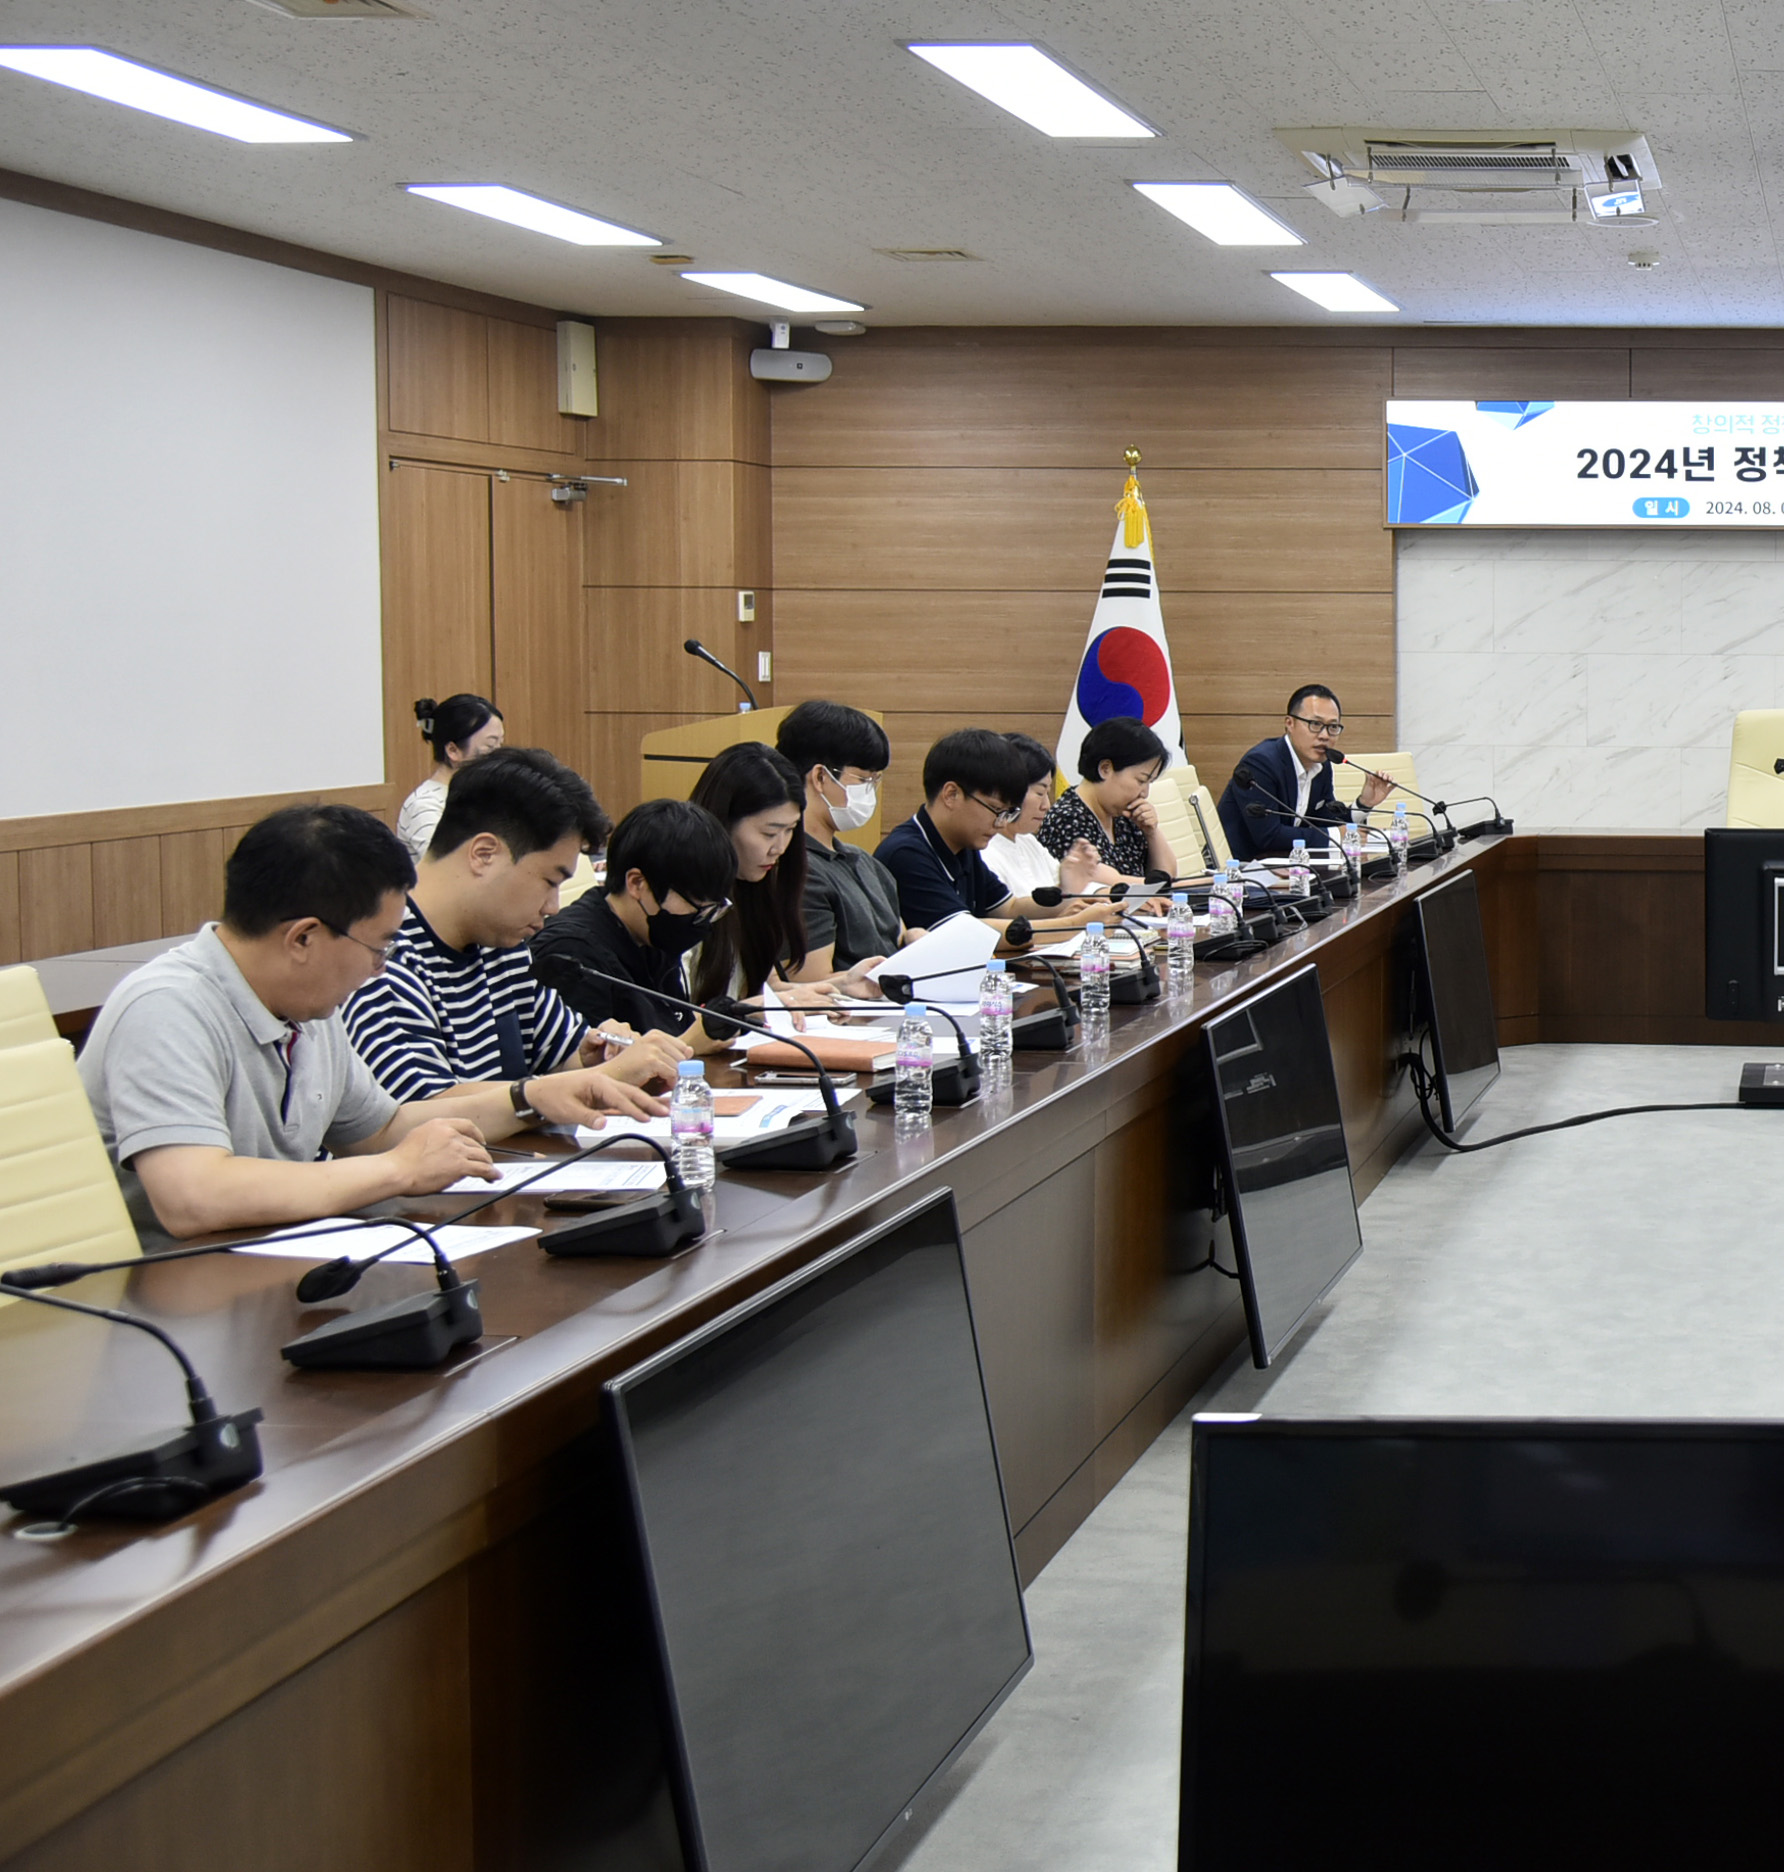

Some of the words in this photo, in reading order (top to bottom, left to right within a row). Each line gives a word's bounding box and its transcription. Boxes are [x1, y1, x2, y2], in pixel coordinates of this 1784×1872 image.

[1692, 414, 1754, 435] 창의적
[1576, 446, 1715, 482] 2024년
[1706, 501, 1748, 515] 2024.
[1752, 501, 1776, 515] 08.
